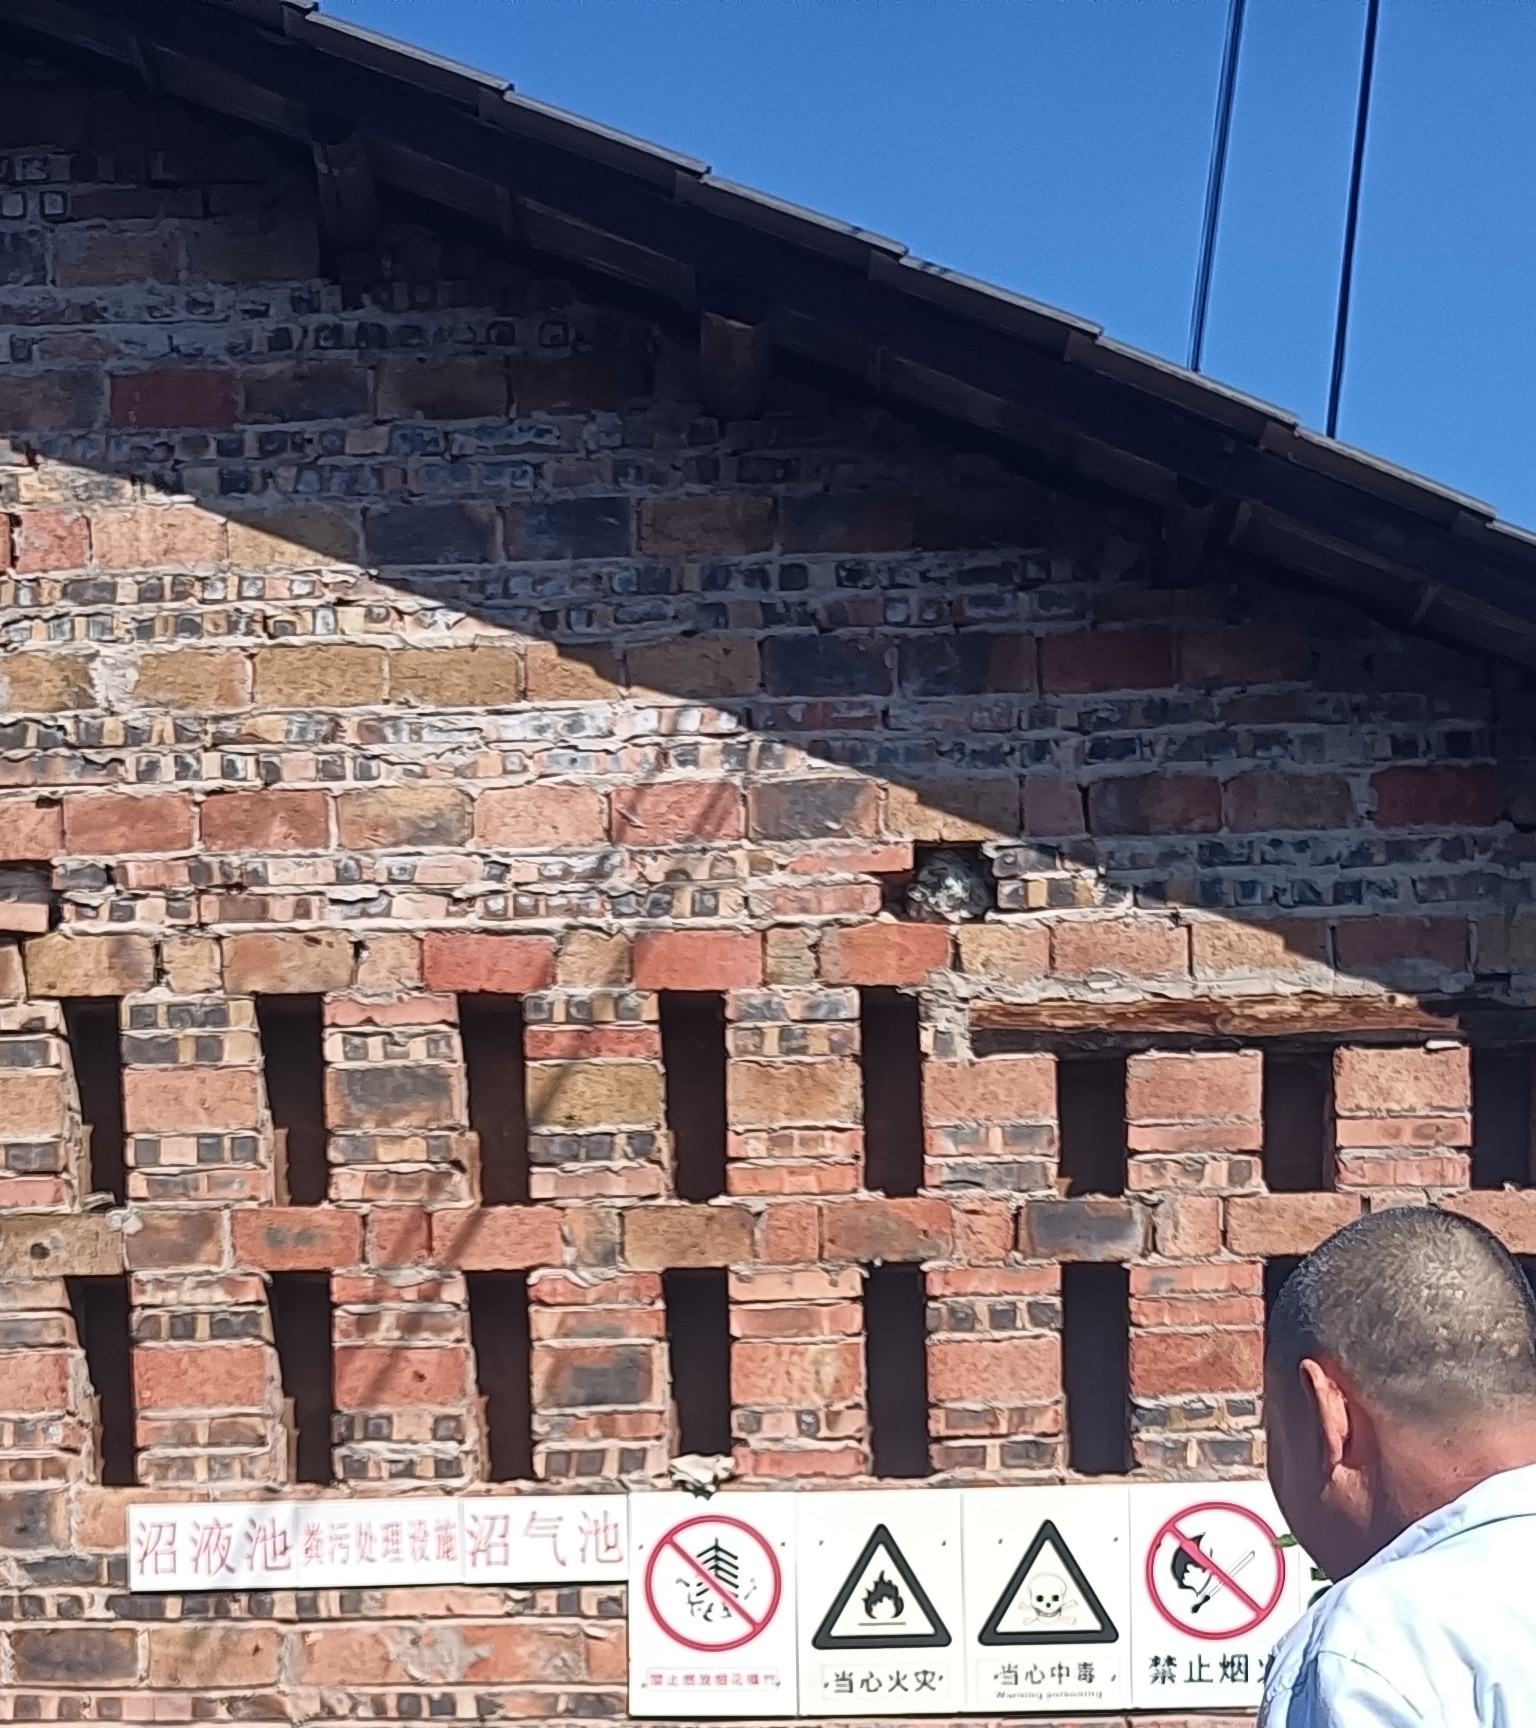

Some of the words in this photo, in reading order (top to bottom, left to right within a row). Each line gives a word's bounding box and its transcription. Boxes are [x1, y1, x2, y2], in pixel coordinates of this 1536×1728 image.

[135, 1516, 293, 1576] 沼液池
[301, 1518, 458, 1567] 粪污处理设施
[468, 1509, 625, 1568] 沼气池
[834, 1670, 937, 1693] 当心火灾
[999, 1662, 1097, 1685] 当心中毒
